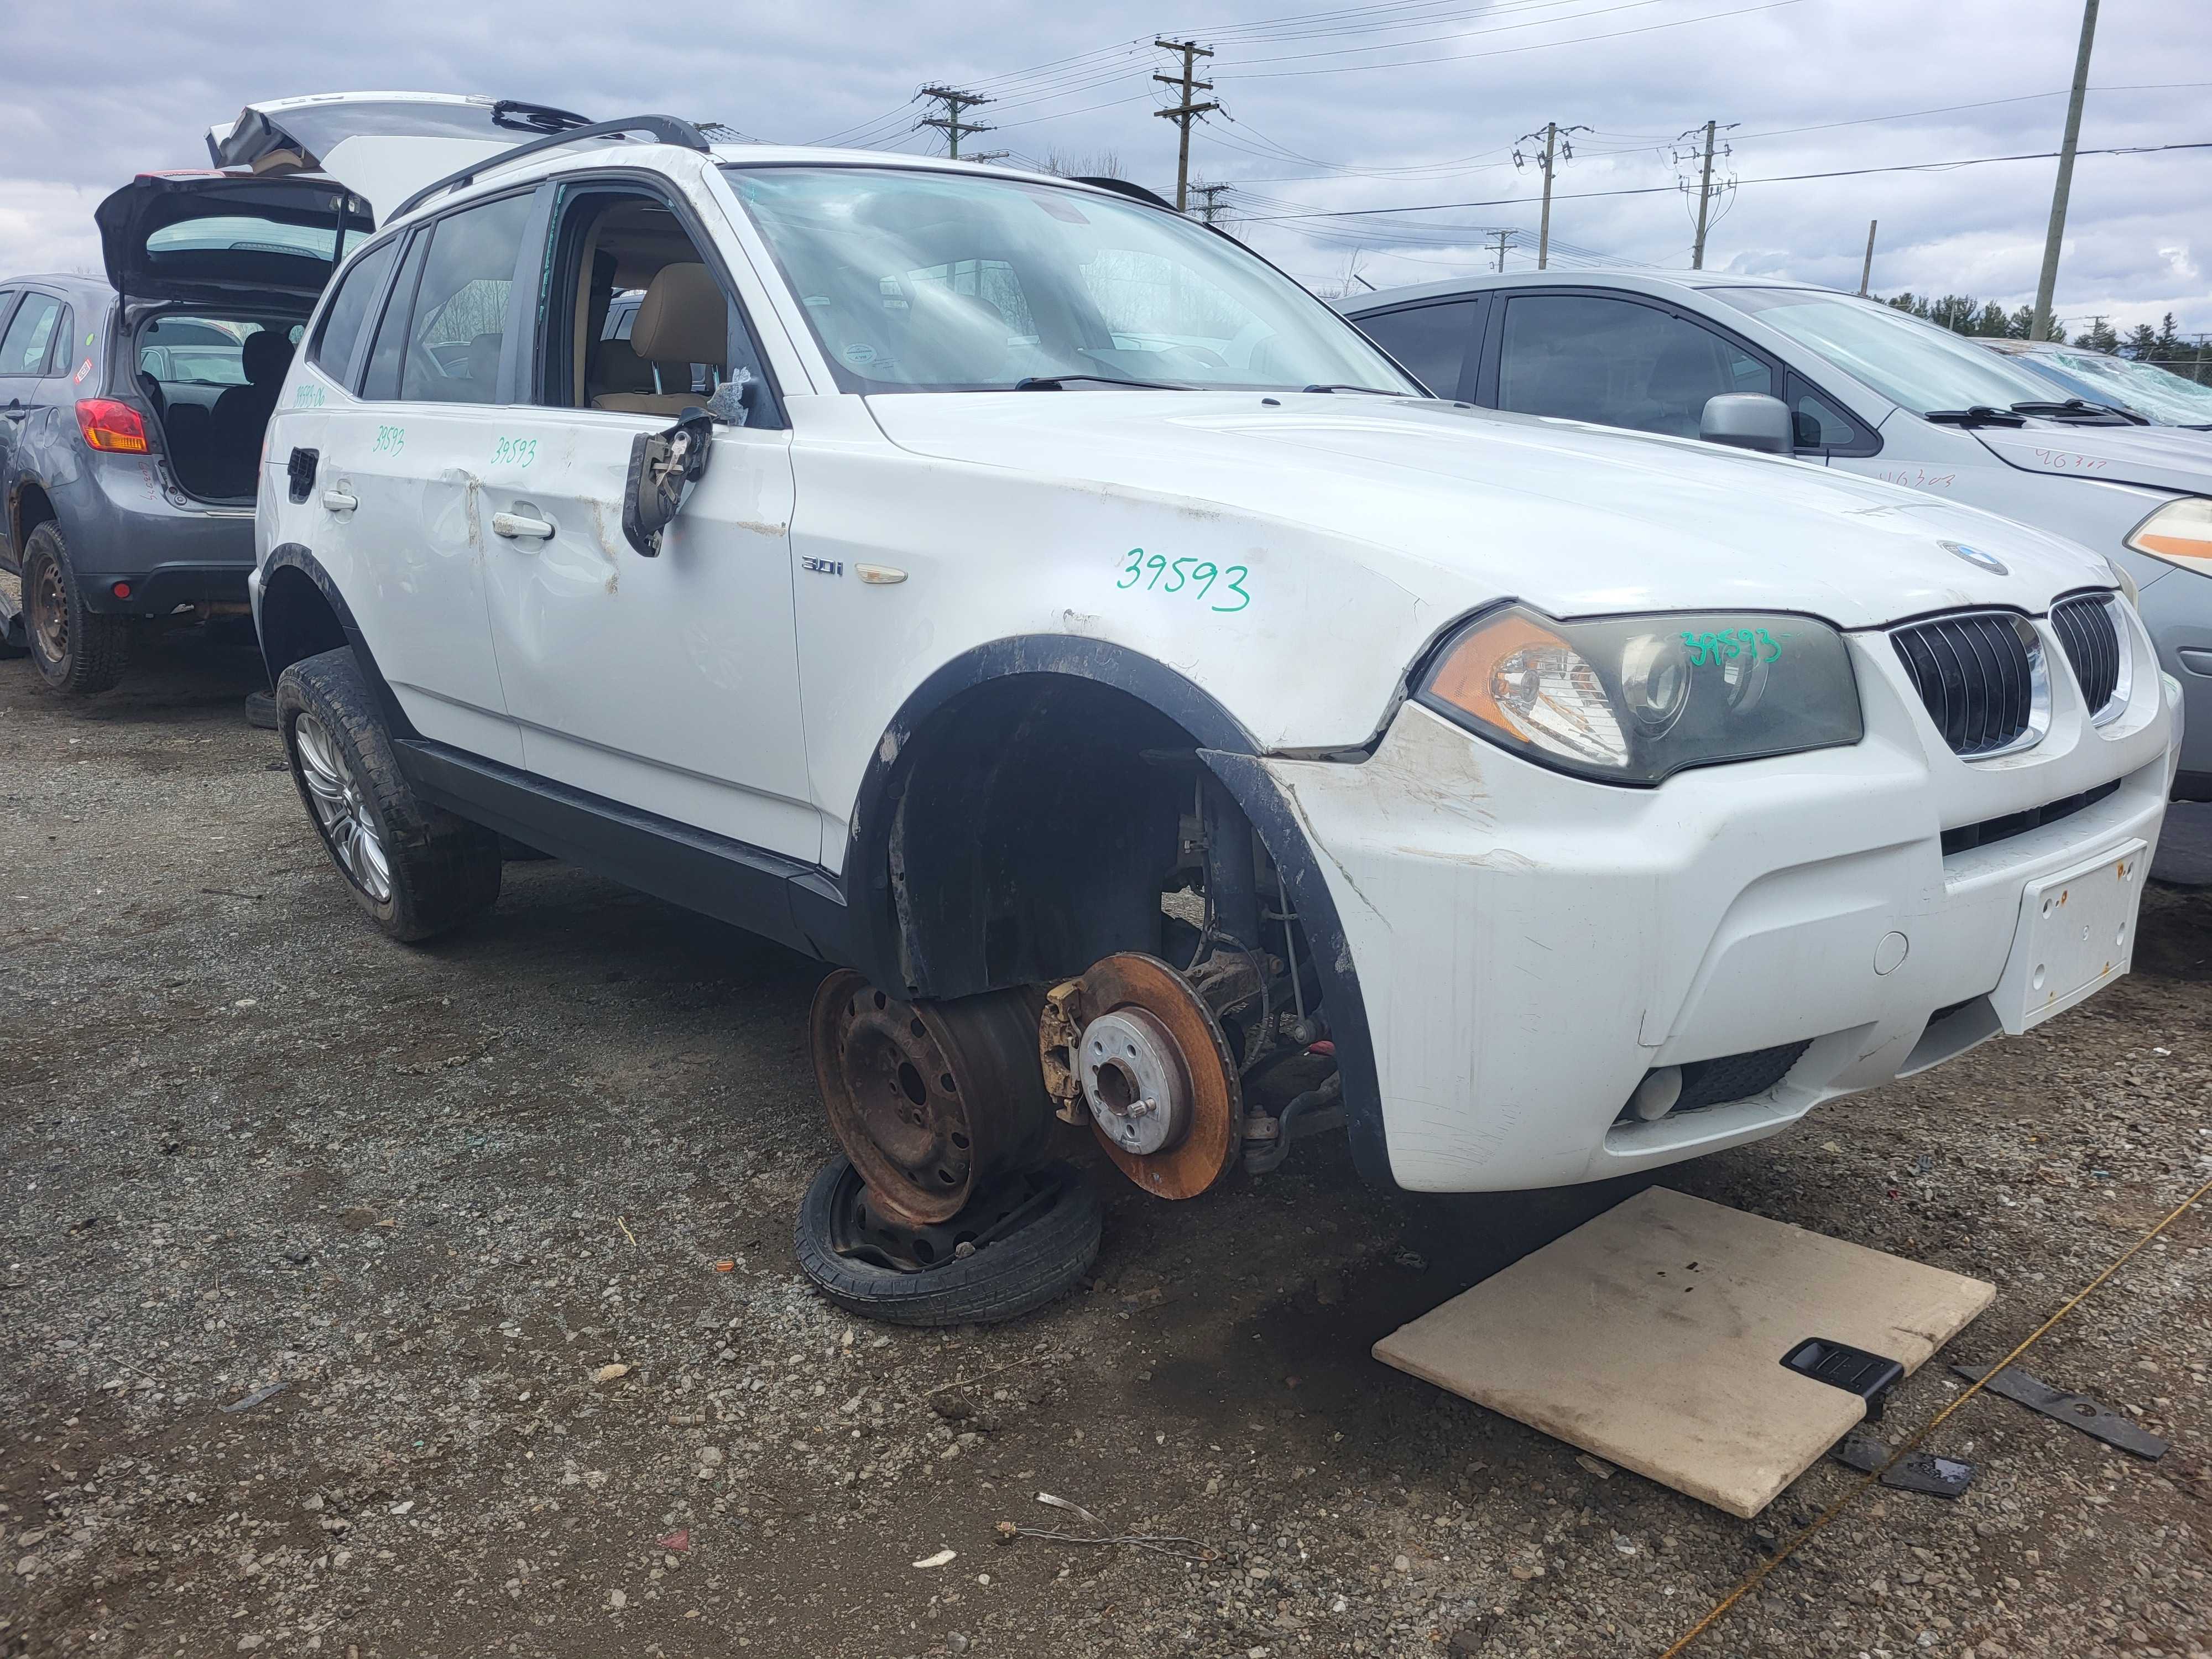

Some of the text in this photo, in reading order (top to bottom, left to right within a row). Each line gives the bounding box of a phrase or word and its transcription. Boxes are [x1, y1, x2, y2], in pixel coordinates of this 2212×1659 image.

[372, 425, 404, 457] 39593
[491, 436, 537, 468] 39593
[1117, 547, 1250, 612] 39593
[1681, 628, 1782, 666] 39593
